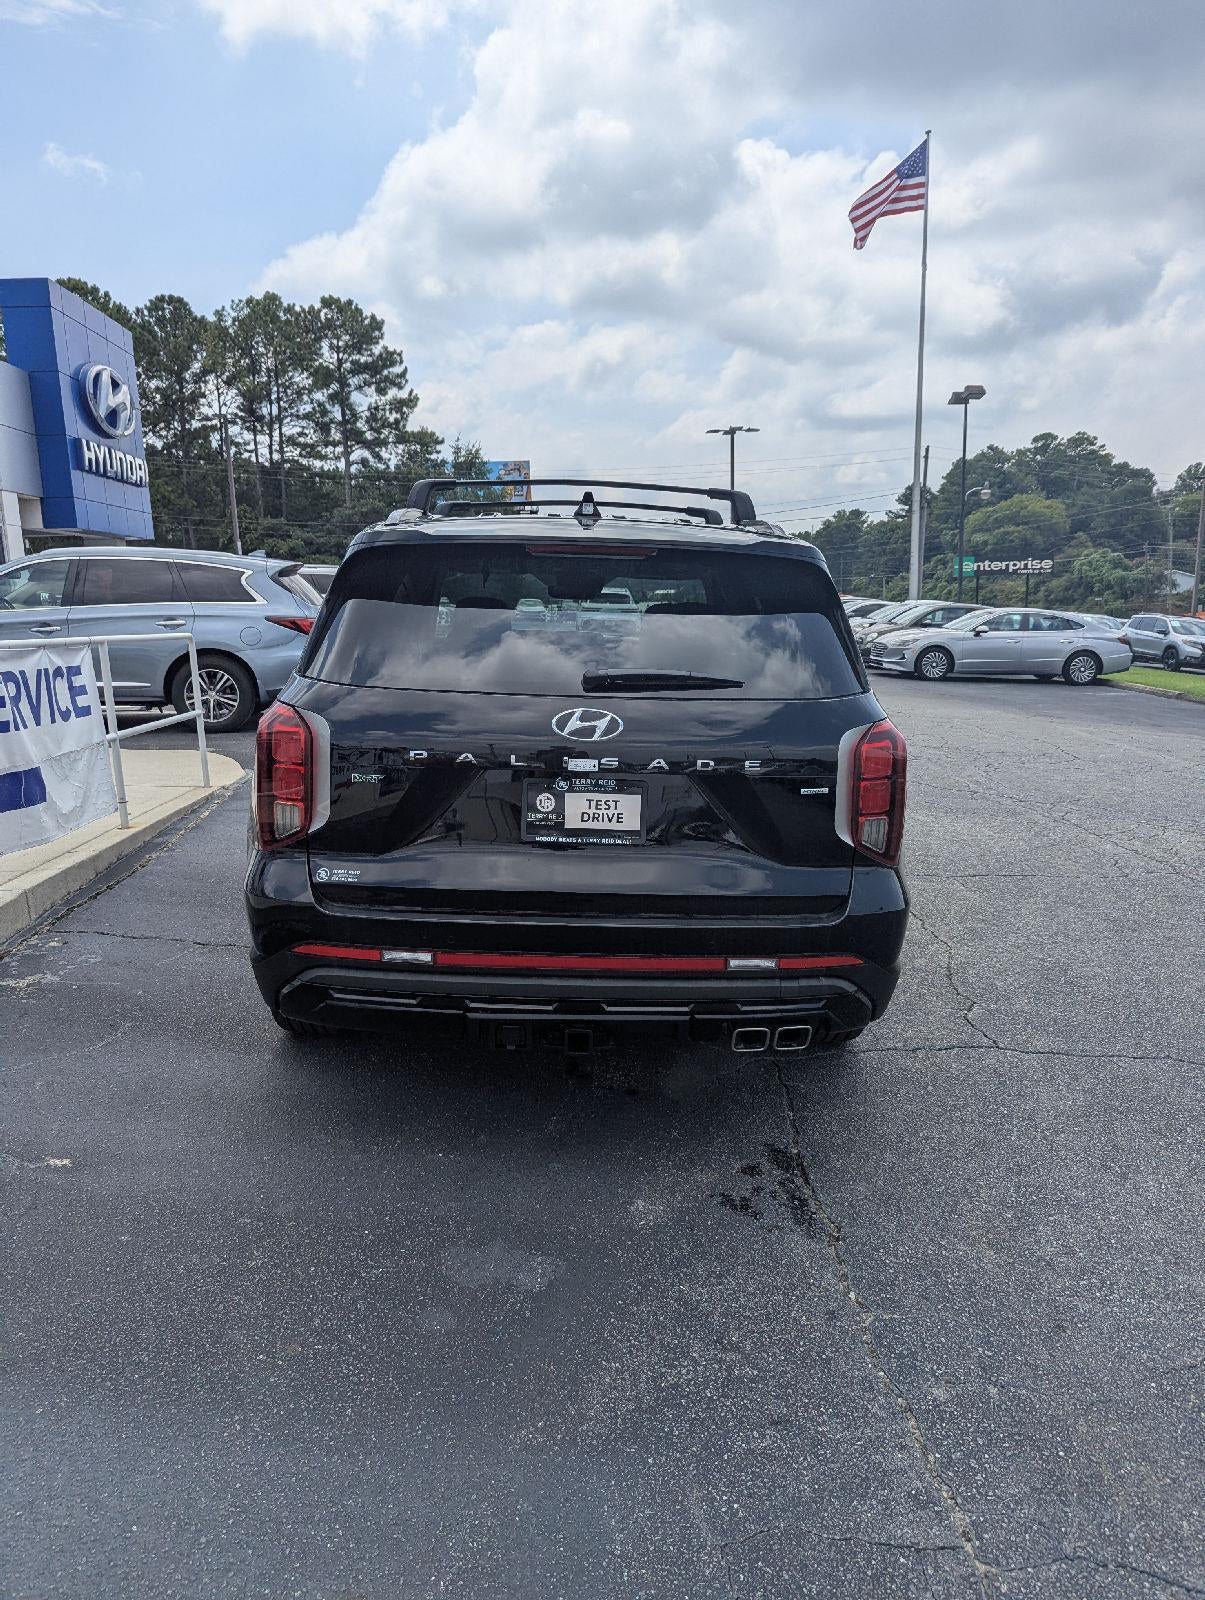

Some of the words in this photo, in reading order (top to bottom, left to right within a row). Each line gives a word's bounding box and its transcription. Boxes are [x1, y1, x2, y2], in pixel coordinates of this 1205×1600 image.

[82, 438, 149, 488] HYUNDAI
[960, 557, 1054, 573] enterprise
[585, 798, 621, 811] TEST
[580, 811, 624, 824] DRIVE
